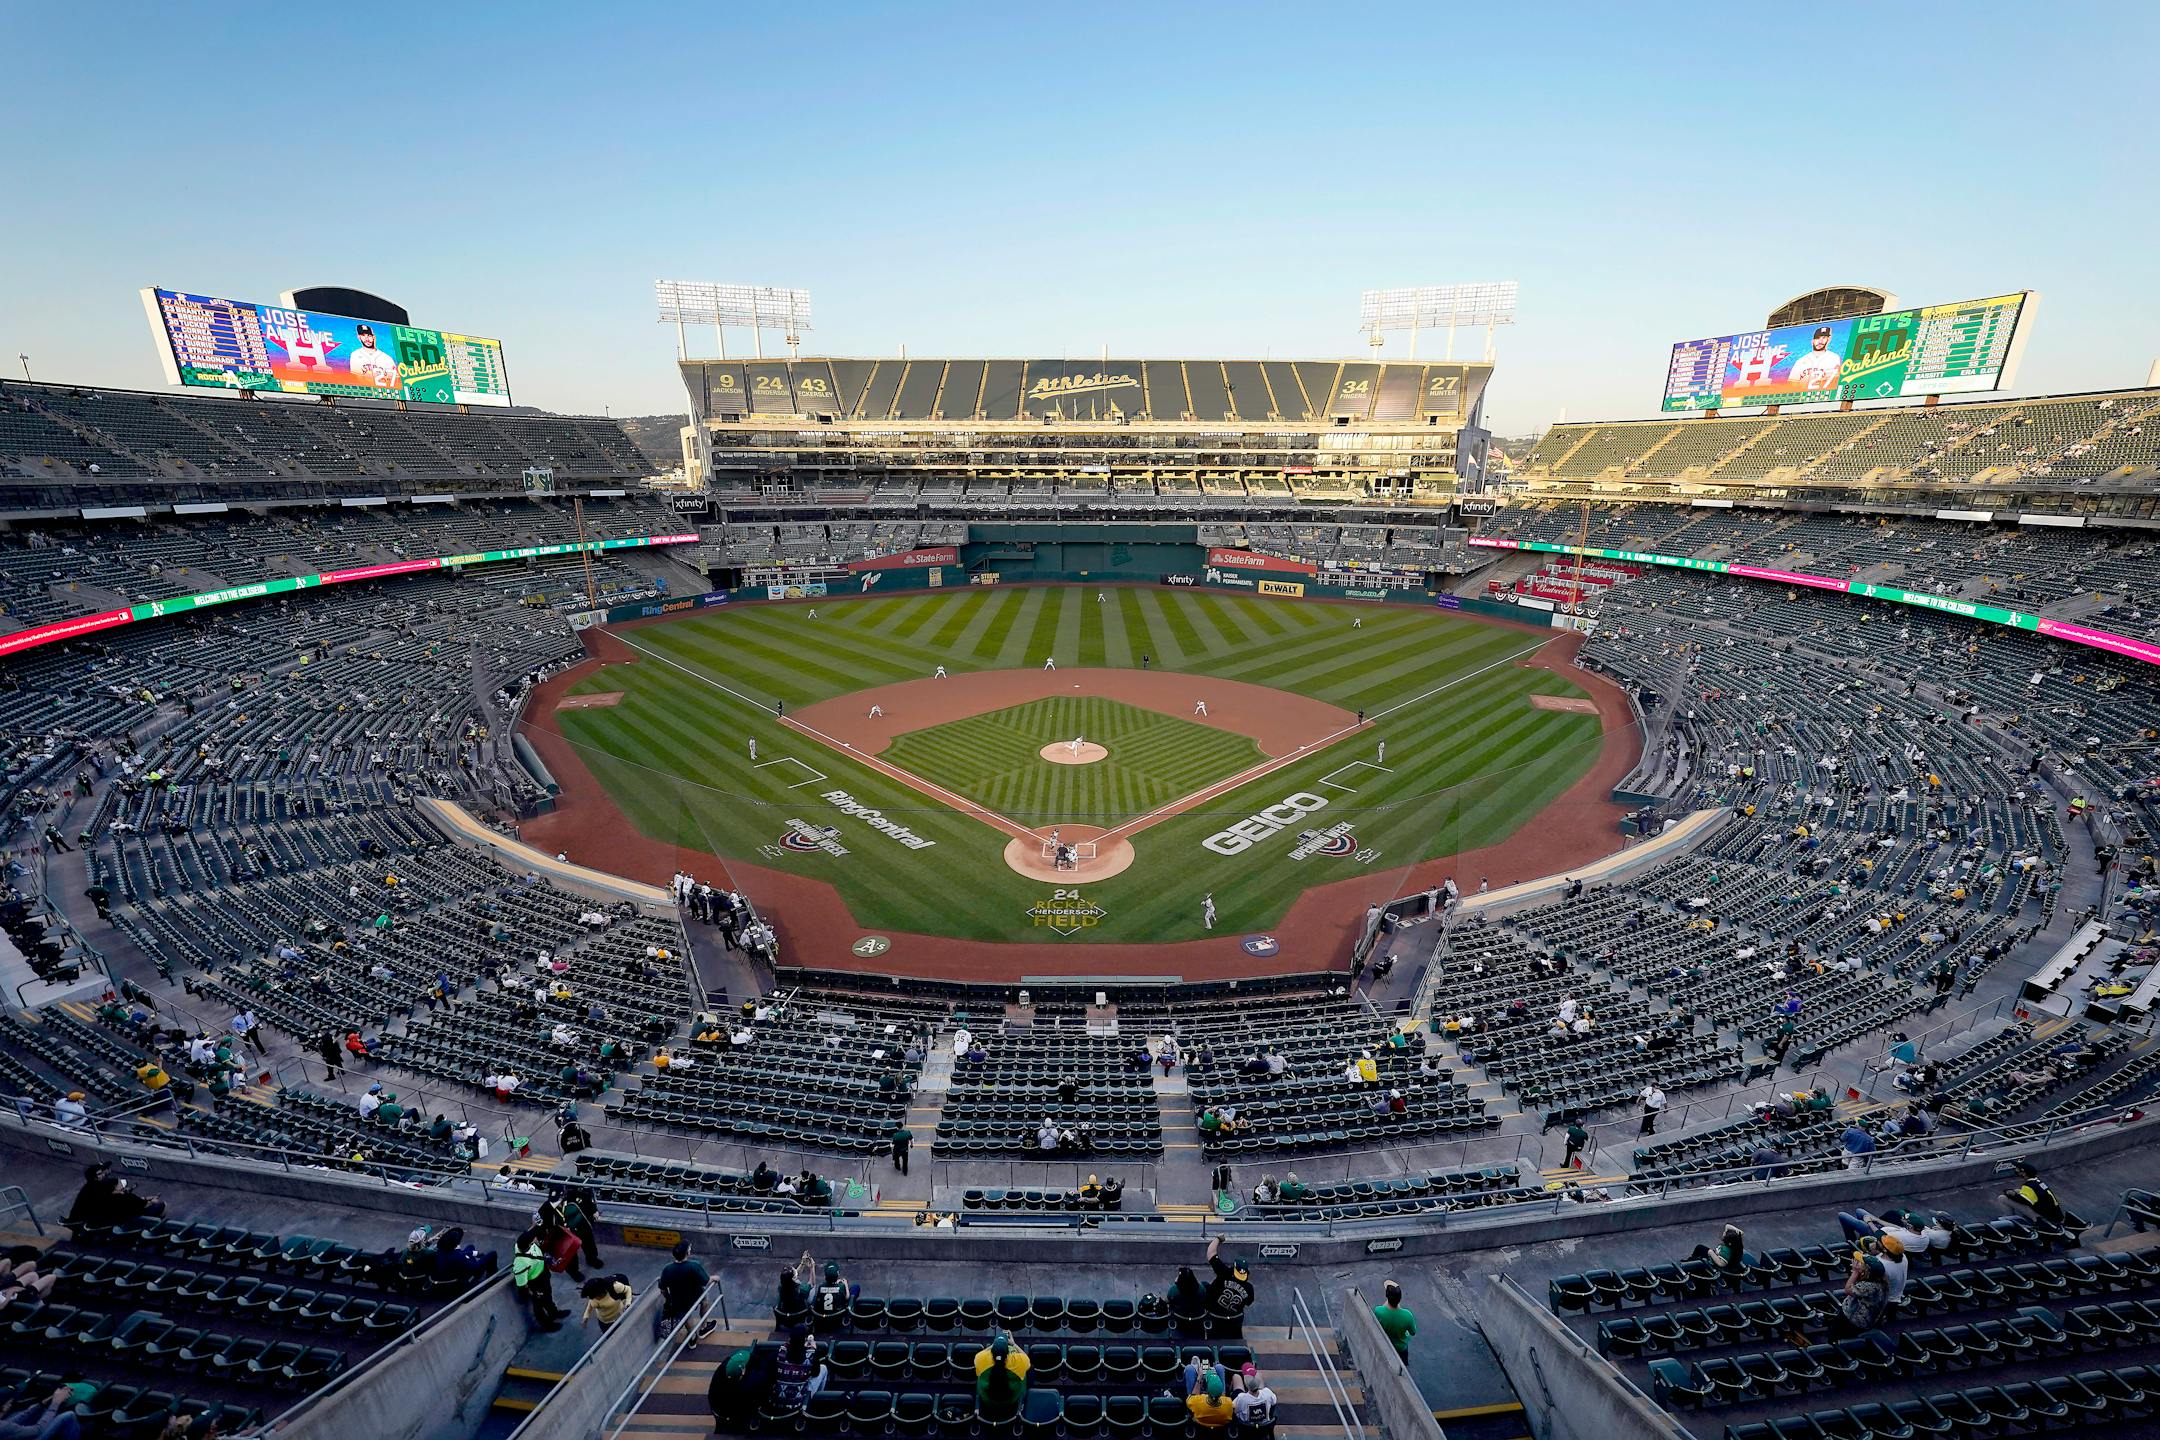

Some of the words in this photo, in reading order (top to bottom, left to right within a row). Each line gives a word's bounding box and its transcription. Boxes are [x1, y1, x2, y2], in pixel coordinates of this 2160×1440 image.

[174, 299, 202, 309] ALTUVE
[175, 306, 215, 317] BRANTLEY
[261, 308, 308, 328] JOSE
[179, 319, 209, 329] TUCKER
[1858, 312, 1912, 333] LET'S
[1928, 324, 1954, 332] OLSON
[1931, 316, 1970, 326] LAUREANO
[181, 327, 212, 335] CORREA
[184, 333, 216, 342] ALVAREZ
[266, 326, 335, 347] ALTUVE
[396, 327, 438, 344] LET'S
[1927, 329, 1964, 339] CHAPMAN
[1733, 333, 1772, 349] JOSE
[1852, 330, 1908, 360] GO
[1925, 336, 1966, 345] MORELAND
[190, 354, 236, 364] MALDONADO
[400, 341, 441, 366] GO
[1729, 344, 1788, 363] ALTUVE
[1840, 339, 1912, 375] Oakland
[1921, 349, 1953, 358] MURPHY
[398, 356, 449, 377] Oakland
[1918, 364, 1947, 372] ANDRUS
[720, 374, 734, 388] 9
[757, 377, 783, 390] 24
[801, 378, 827, 392] 43
[1028, 373, 1140, 398] Athletics
[1342, 380, 1368, 394] 34
[1431, 377, 1459, 391] 27
[675, 499, 705, 510] xfinity
[1463, 501, 1493, 513] xfinity
[465, 553, 485, 562] BASSITT
[916, 554, 953, 564] StateFarm
[1223, 554, 1265, 566] StateFarm
[1168, 574, 1194, 585] xfinity
[194, 592, 220, 605] WELCOME
[220, 591, 228, 600] TO
[228, 590, 238, 599] THE
[238, 585, 267, 597] COLISEUM
[1536, 584, 1574, 596] Budweiser
[642, 599, 694, 616] RingCentral
[1903, 593, 1931, 605] WELCOME
[1930, 598, 1938, 606] TO
[1938, 599, 1948, 608] THE
[1948, 601, 1977, 615] COLISEUM
[2005, 612, 2022, 627] A's
[820, 790, 936, 850] RingCentral
[1201, 792, 1329, 856] GEICO
[1325, 821, 1356, 838] WEEK
[817, 838, 851, 858] WEEK
[1054, 889, 1079, 900] 24
[1036, 901, 1096, 909] RICKEY
[1034, 915, 1098, 927] FIELD
[854, 939, 886, 953] A's
[824, 1293, 833, 1310] 2
[1218, 1289, 1243, 1312] 22
